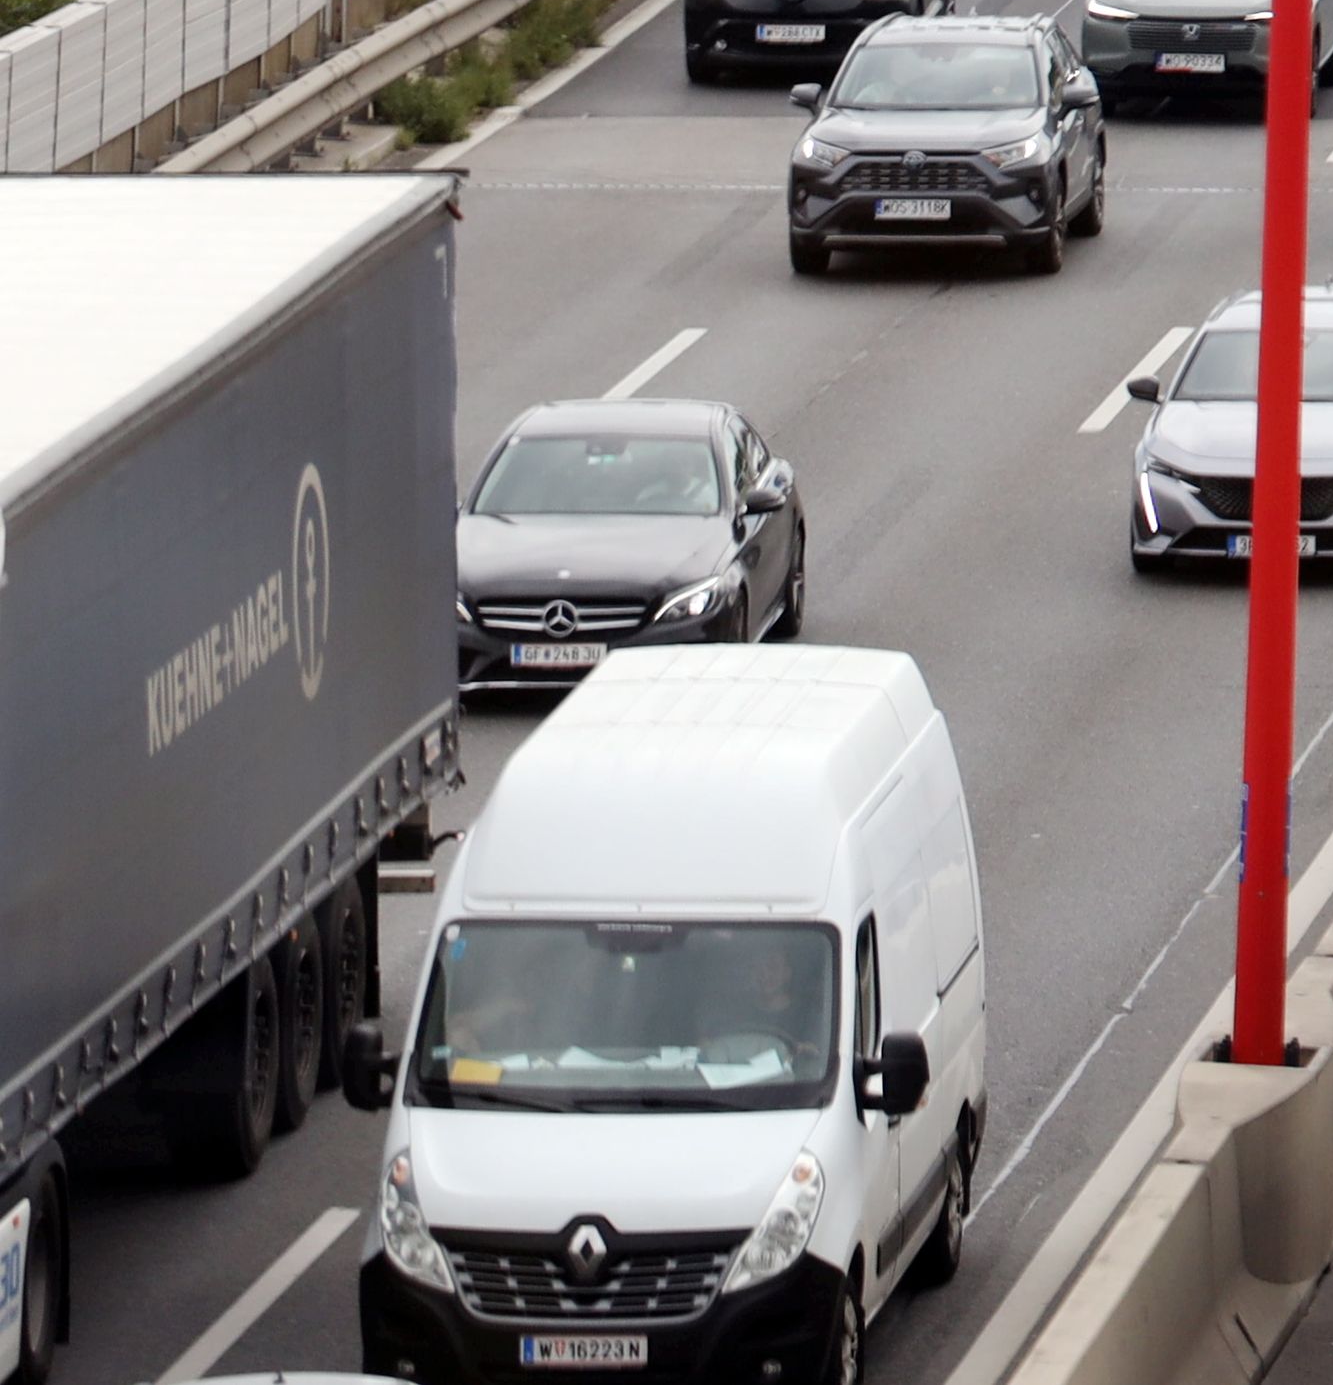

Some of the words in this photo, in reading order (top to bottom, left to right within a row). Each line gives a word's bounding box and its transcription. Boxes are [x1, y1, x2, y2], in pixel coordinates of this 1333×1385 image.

[145, 569, 289, 757] KUEHNE+NAGEL
[540, 1341, 553, 1359] W
[629, 1341, 640, 1358] N
